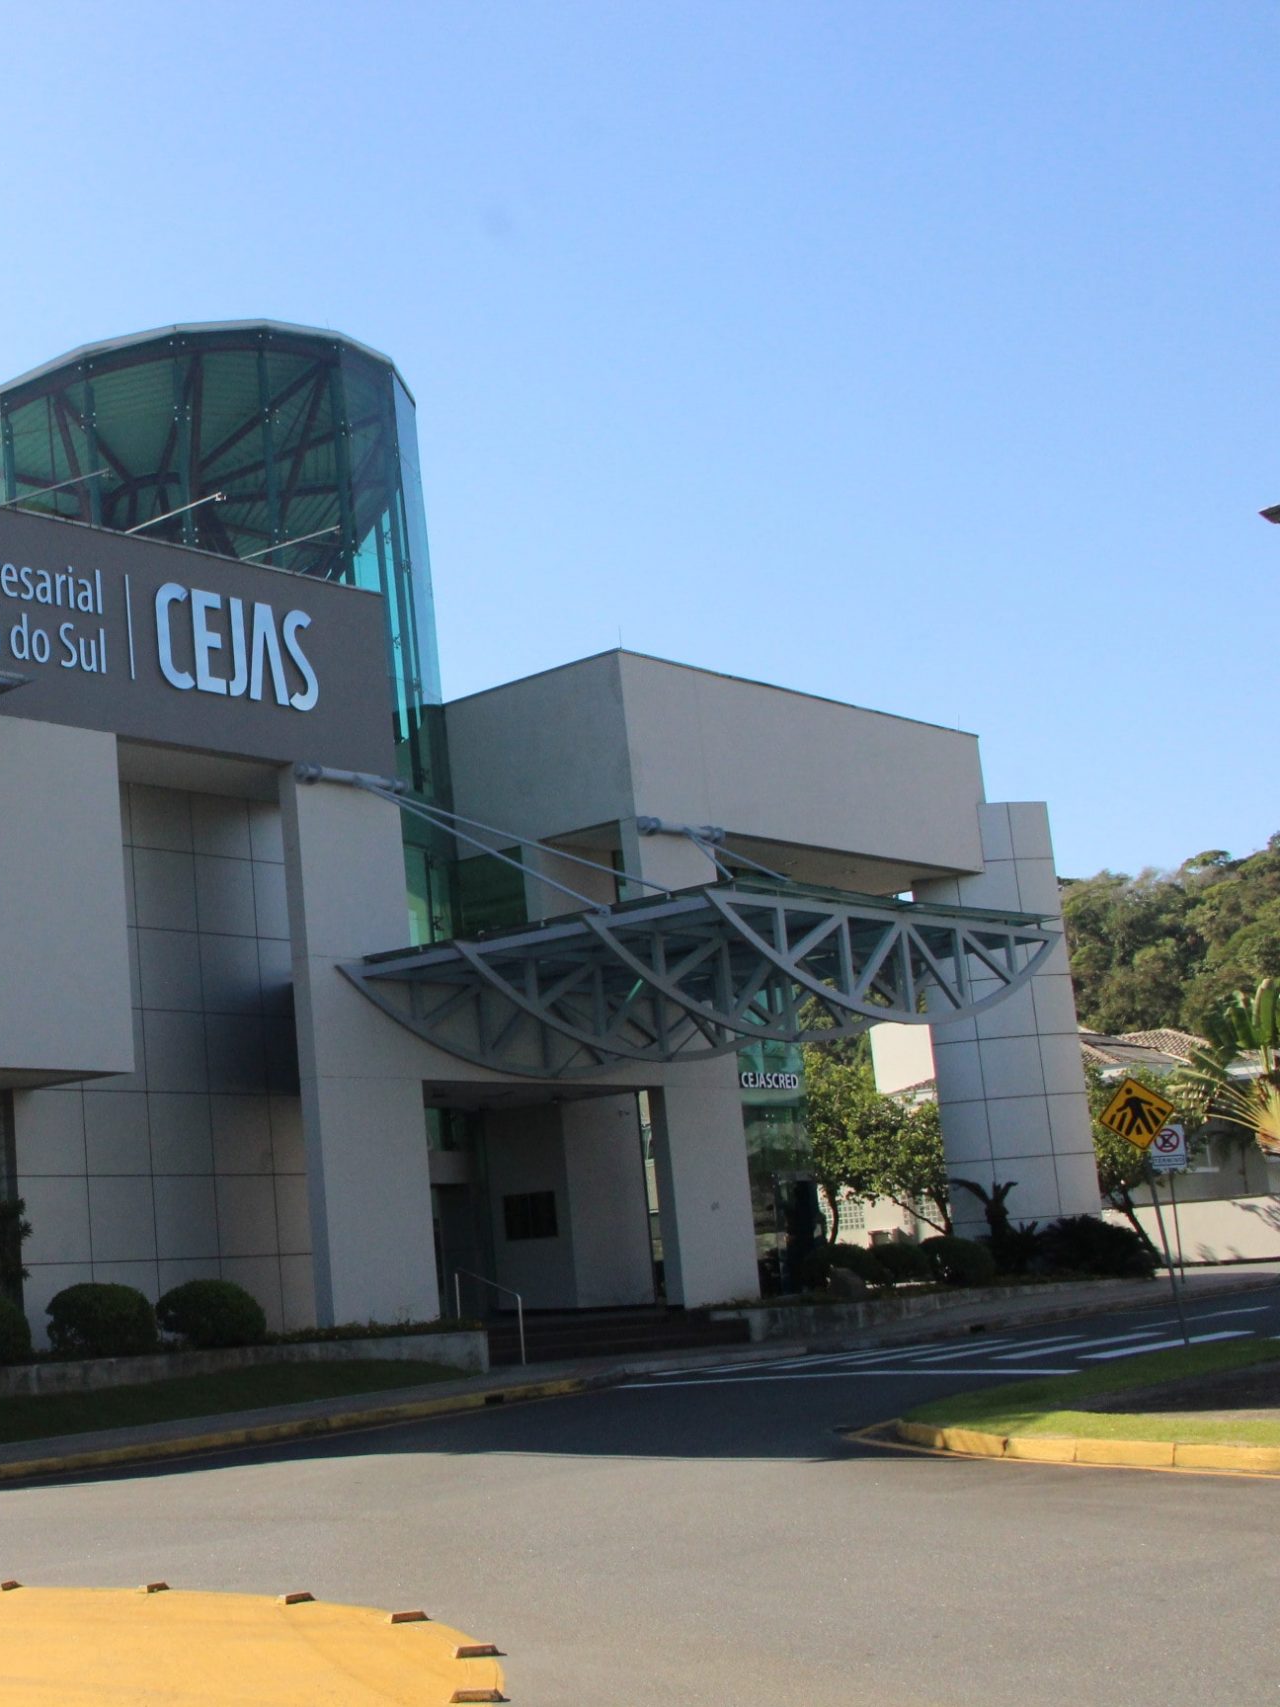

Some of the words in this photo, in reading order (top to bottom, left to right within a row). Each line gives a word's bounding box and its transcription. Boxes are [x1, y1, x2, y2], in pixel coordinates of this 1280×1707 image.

[10, 612, 50, 664] do
[59, 622, 107, 674] Sul
[154, 582, 319, 713] CEJAS
[741, 1071, 799, 1089] CEJASCRED
